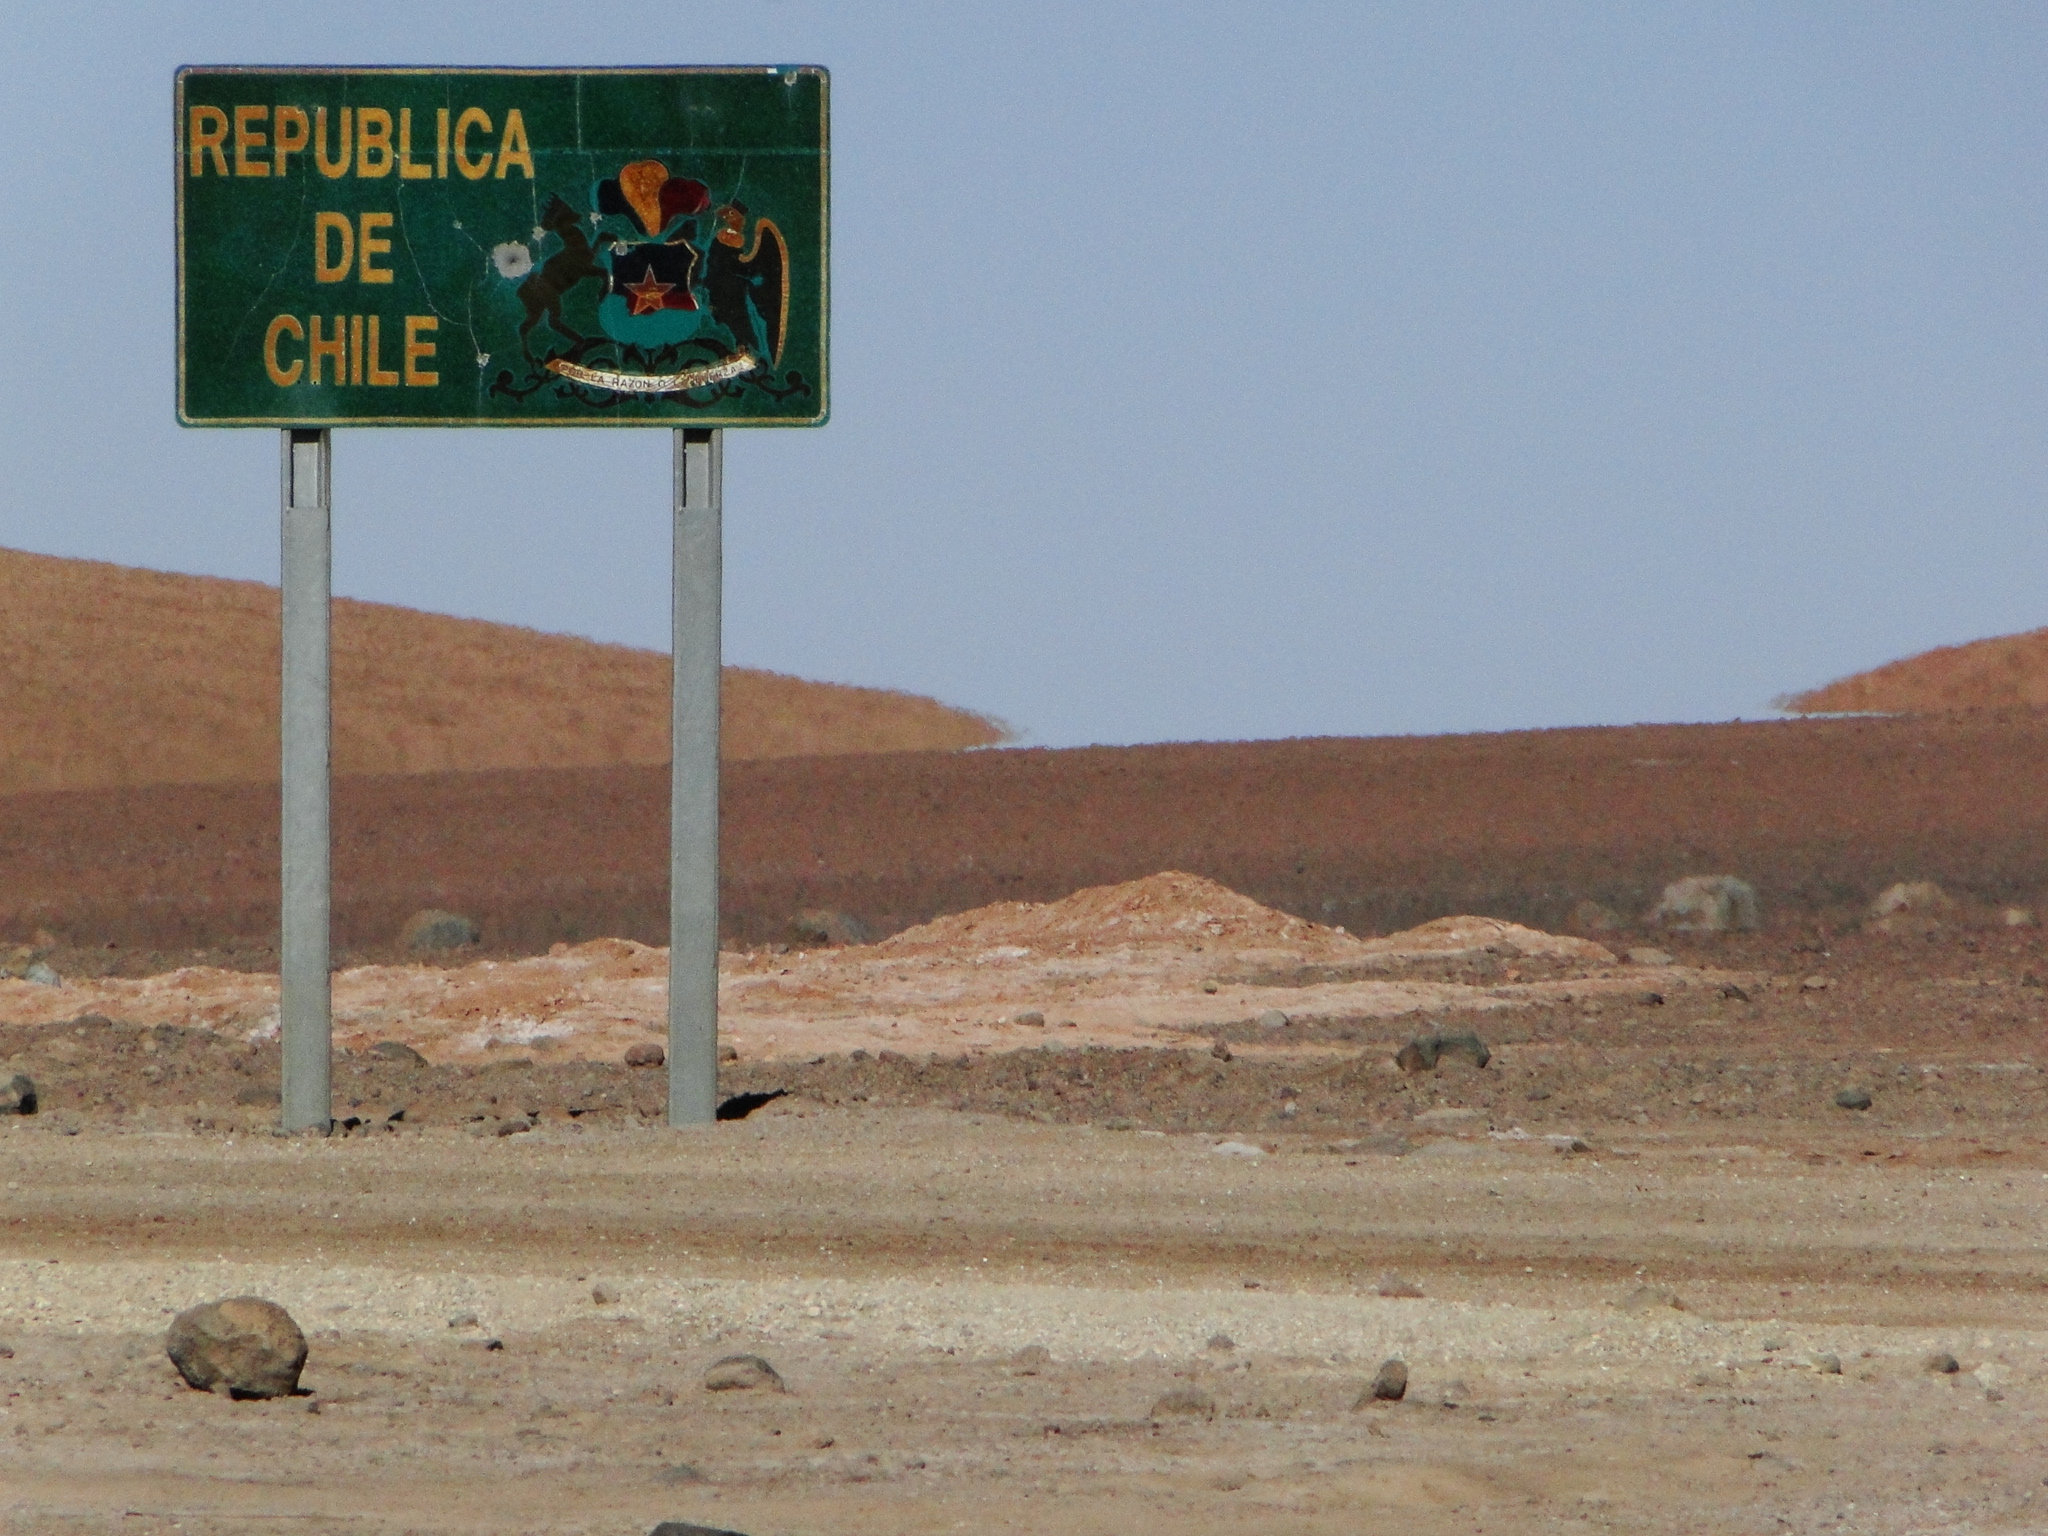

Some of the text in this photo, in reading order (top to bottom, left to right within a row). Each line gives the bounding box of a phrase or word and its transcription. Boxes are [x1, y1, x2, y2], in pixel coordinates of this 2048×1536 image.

[190, 105, 535, 180] REPUBLICA
[315, 211, 394, 283] DE
[265, 314, 439, 387] CHILE
[560, 363, 584, 379] POR
[590, 373, 605, 384] LA
[612, 377, 650, 389] RAZON
